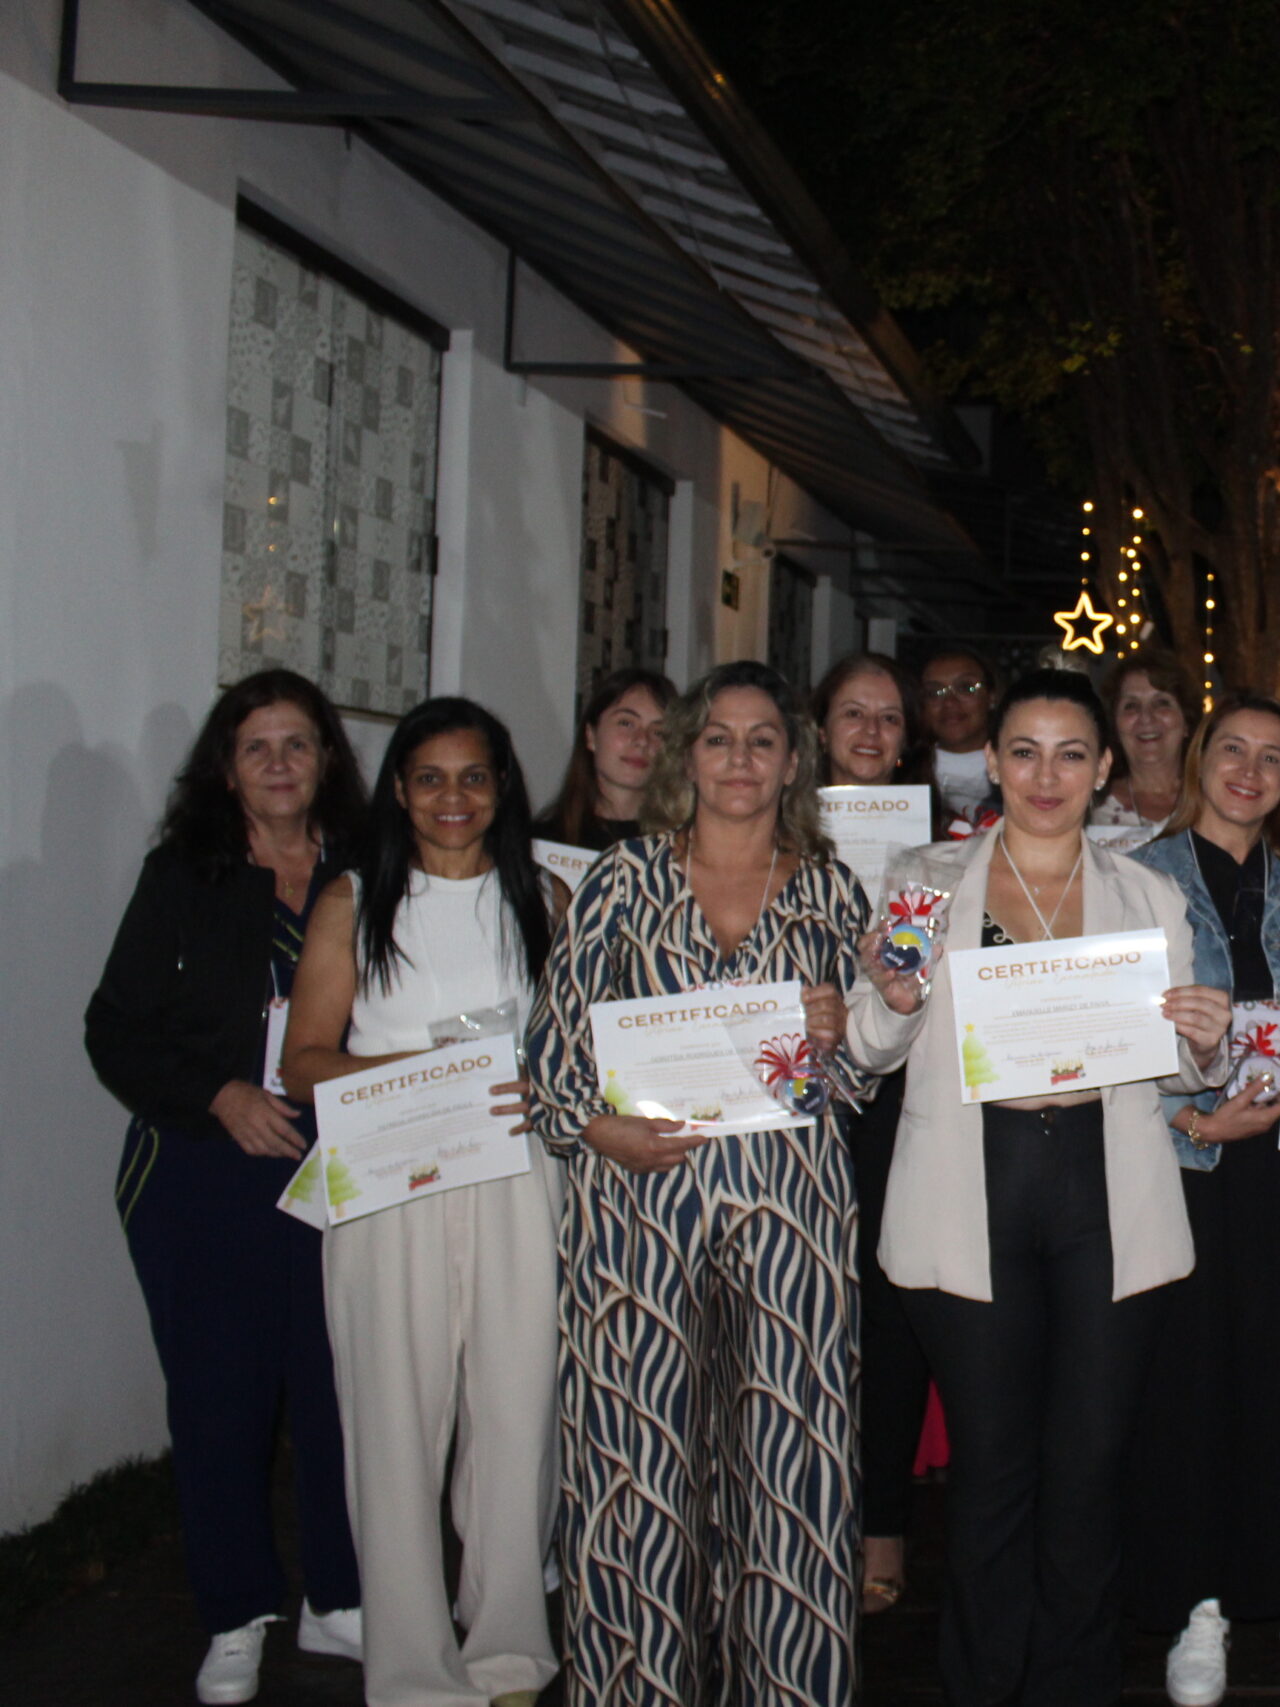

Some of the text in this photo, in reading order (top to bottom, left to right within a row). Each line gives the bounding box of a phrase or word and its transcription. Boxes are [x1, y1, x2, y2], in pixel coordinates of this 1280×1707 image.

[823, 799, 910, 813] IFICADO
[977, 951, 1142, 981] CERTIFICADO
[618, 999, 779, 1029] CERTIFICADO
[340, 1055, 493, 1105] CERTIFICADO
